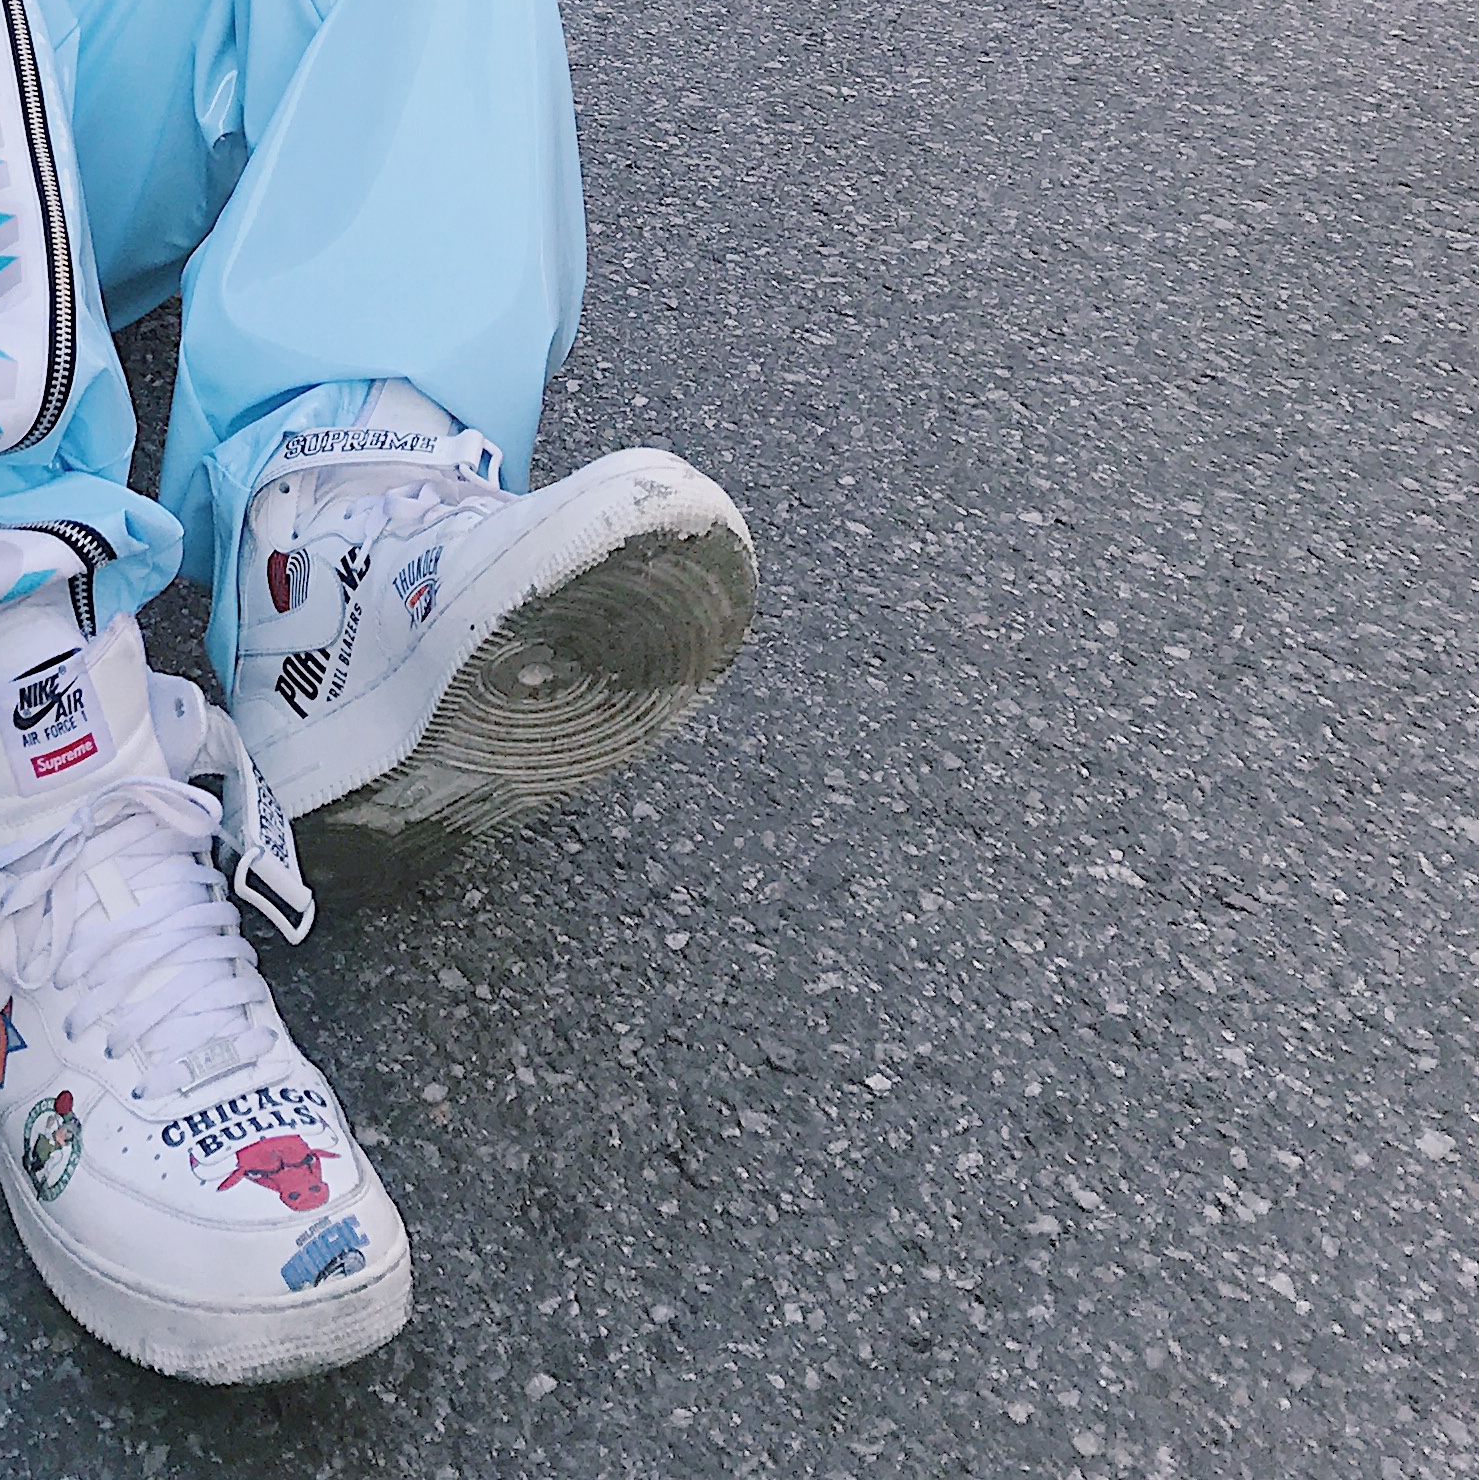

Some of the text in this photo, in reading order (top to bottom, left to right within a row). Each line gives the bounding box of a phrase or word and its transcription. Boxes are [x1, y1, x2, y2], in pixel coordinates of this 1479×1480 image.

[284, 428, 438, 460] SUPREME
[392, 545, 445, 600] THUNDER
[326, 602, 363, 703] TRAIL BLAZERS
[19, 672, 61, 711] NIKE
[55, 688, 85, 723] AIR
[22, 731, 41, 748] AIR
[44, 715, 78, 740] FORCE
[36, 740, 94, 772] Supreme
[161, 1086, 327, 1148] CHICAGO
[195, 1104, 318, 1158] BULLS
